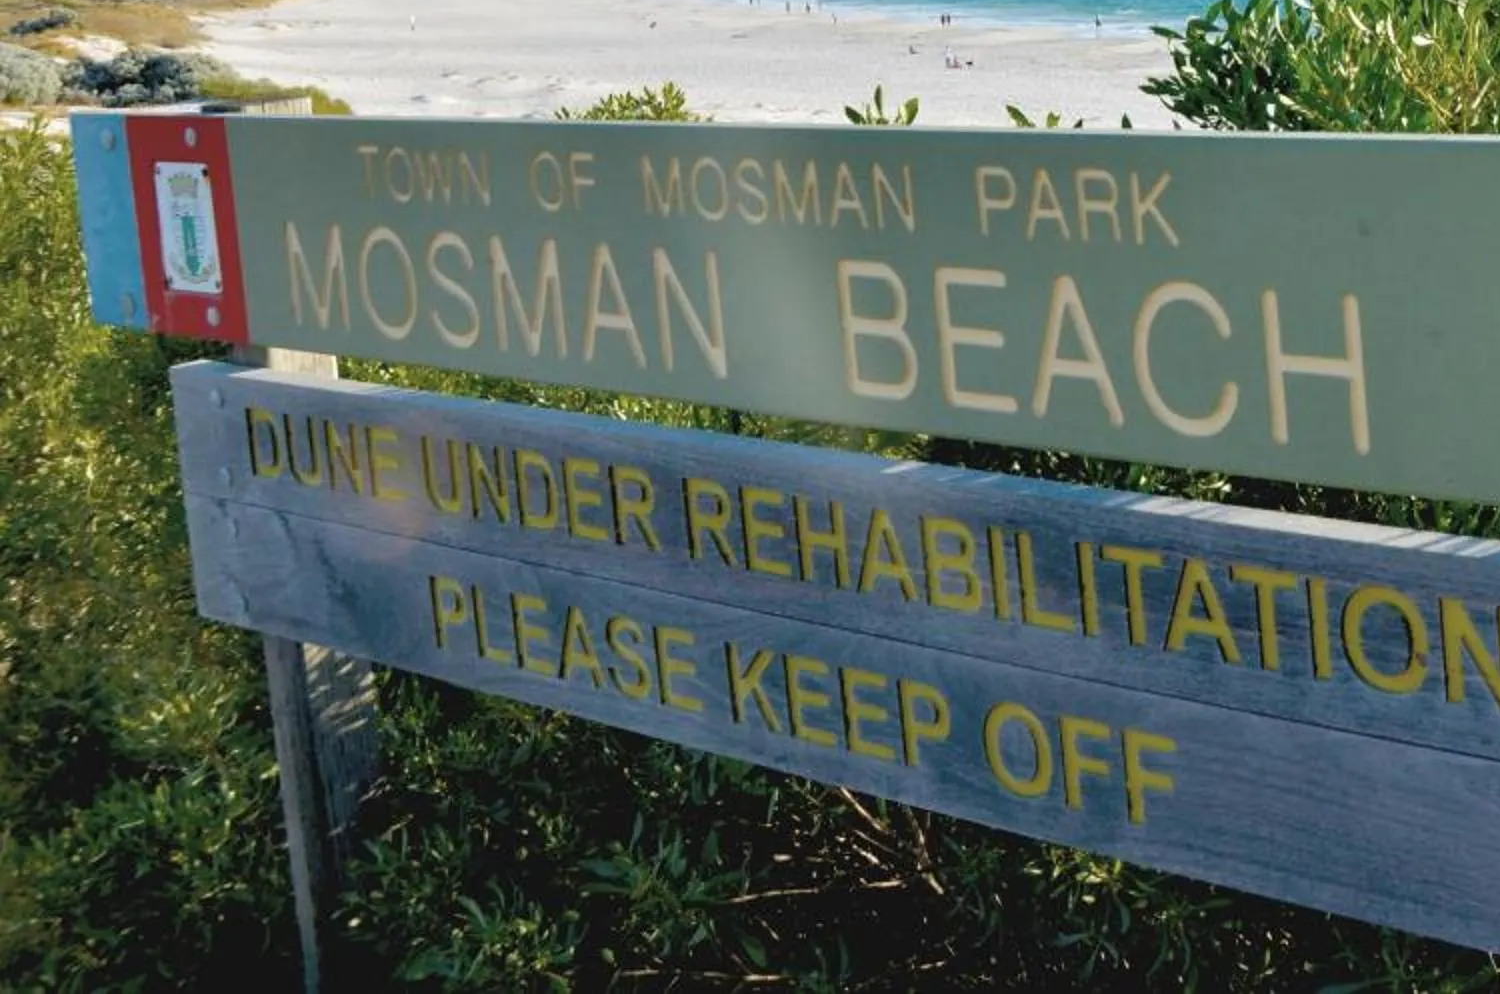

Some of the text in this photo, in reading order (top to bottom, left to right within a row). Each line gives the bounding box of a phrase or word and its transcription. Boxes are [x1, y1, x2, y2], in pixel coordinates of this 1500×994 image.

[357, 145, 1180, 247] TOWN OF MOSMAN PARK
[286, 220, 1370, 456] MOSMAN BEACH
[244, 406, 405, 500] DUNE
[420, 434, 662, 552] UNDER
[428, 574, 1178, 824] PLEASE KEEP OFF
